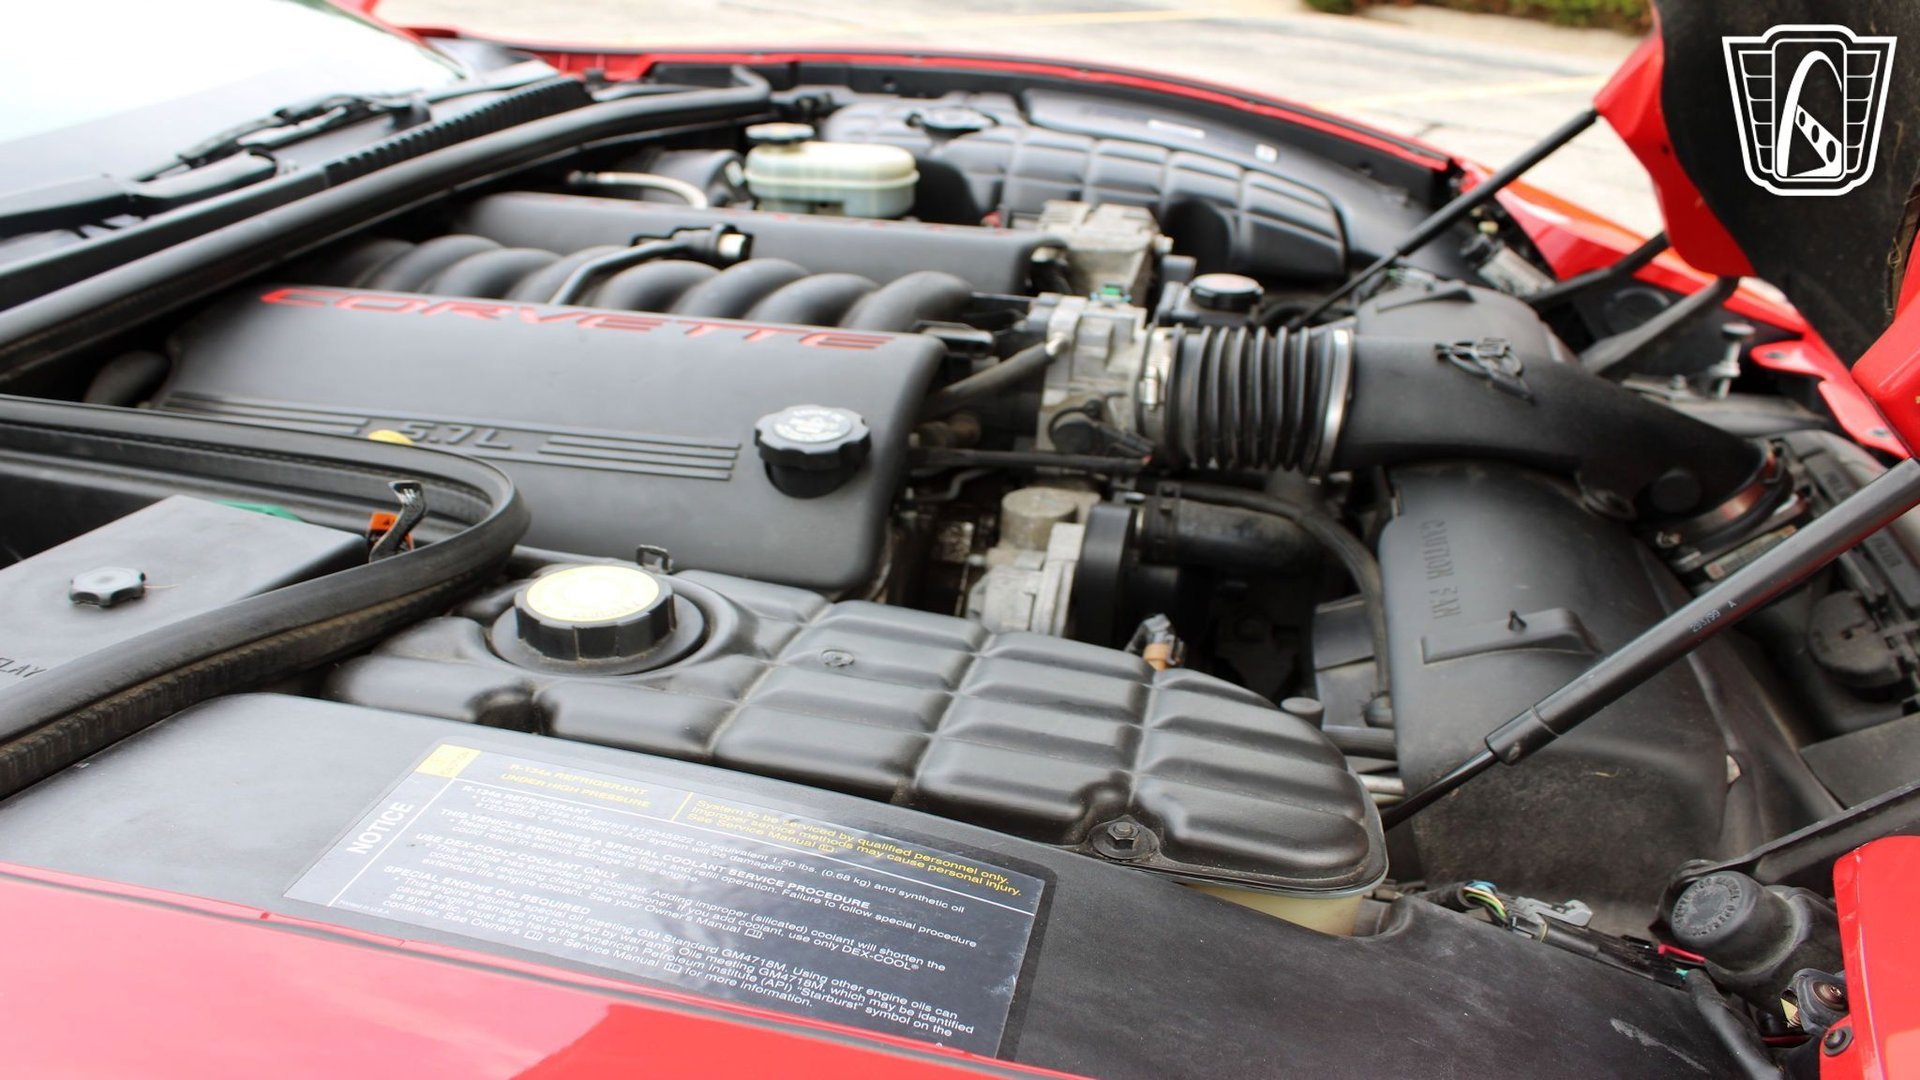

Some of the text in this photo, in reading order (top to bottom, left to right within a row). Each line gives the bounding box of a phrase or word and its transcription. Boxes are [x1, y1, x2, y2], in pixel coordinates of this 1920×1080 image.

[261, 287, 894, 350] CORVETTE
[398, 421, 511, 450] 5.7L
[0, 657, 47, 678] LAY
[502, 793, 591, 815] REFRIGERANT
[546, 782, 578, 792] HIGH
[346, 802, 415, 855] NOTICE
[414, 832, 619, 879] USE COOLANT ONLY
[438, 808, 469, 818] THIS
[469, 814, 524, 829] VEHICLE
[524, 825, 592, 843] REQUIRES
[604, 841, 661, 858] SPECIAL
[661, 853, 726, 872] COOLANT
[728, 868, 785, 886] SERVICE
[787, 882, 870, 909] PROCEDURE
[687, 813, 815, 847] See Service Manual
[691, 807, 1021, 896] Improper service methods may cause personal injury.
[696, 800, 743, 814] System
[838, 833, 854, 842] by
[856, 839, 911, 856] qualified
[914, 854, 976, 874] personnel
[980, 872, 1008, 884] only.
[382, 864, 592, 914] SPECIAL ENGINE OIL REQUIRED
[637, 864, 656, 872] the
[710, 844, 768, 860] equivalent
[771, 857, 796, 867] 1.50
[797, 863, 816, 872] lbs.
[820, 869, 850, 881] (0.68
[852, 877, 871, 888] kg)
[873, 884, 895, 893] and
[898, 891, 947, 908] synthetic
[729, 854, 784, 871] damaged.
[587, 892, 612, 902] See
[613, 899, 642, 908] your
[696, 916, 742, 932] Manual
[594, 887, 628, 897] much
[686, 908, 709, 916] you
[712, 913, 736, 922] add
[788, 932, 810, 941] use
[813, 939, 838, 951] only
[651, 889, 693, 905] Adding
[695, 899, 749, 917] improper
[750, 913, 809, 934] (silicated)
[810, 929, 855, 945] coolant
[857, 942, 877, 951] will
[879, 948, 924, 964] shorten
[926, 960, 946, 971] the
[669, 864, 692, 872] and
[694, 869, 719, 878] refill
[721, 876, 776, 892] operation.
[781, 888, 821, 903] Failure
[824, 899, 835, 907] to
[838, 903, 871, 917] follow
[874, 914, 916, 929] special
[918, 926, 977, 947] procedure
[380, 902, 437, 917] container.
[441, 913, 466, 923] See
[562, 939, 609, 954] Service
[612, 950, 660, 966] Manual
[684, 967, 701, 976] for
[704, 973, 737, 985] more
[739, 981, 812, 1006] information.
[394, 887, 431, 897] cause
[432, 895, 474, 906] engine
[475, 902, 525, 917] damage
[549, 919, 599, 933] covered
[600, 929, 617, 939] by
[619, 935, 672, 951] warranty.
[678, 947, 702, 958] Oils
[705, 955, 755, 972] meeting
[829, 987, 866, 1001] which
[868, 998, 895, 1012] may
[898, 1005, 914, 1015] be
[917, 1011, 974, 1034] identified
[402, 878, 427, 888] This
[428, 885, 470, 897] engine
[471, 894, 520, 908] requires
[521, 905, 567, 918] special
[584, 918, 634, 934] meeting
[636, 928, 661, 939] GM
[662, 934, 719, 953] Standard
[792, 966, 828, 983] Using
[830, 978, 863, 991] other
[865, 988, 907, 1004] engine
[910, 1001, 931, 1011] oils
[934, 1008, 958, 1019] can
[463, 911, 497, 921] must
[496, 918, 523, 927] also
[524, 922, 556, 934] have
[557, 929, 578, 939] the
[579, 934, 638, 952] American
[641, 948, 705, 968] Petroleum
[707, 963, 757, 982] Institute
[759, 977, 793, 992] (API)
[864, 1007, 910, 1025] symbol
[912, 1021, 929, 1030] on
[932, 1025, 951, 1037] the
